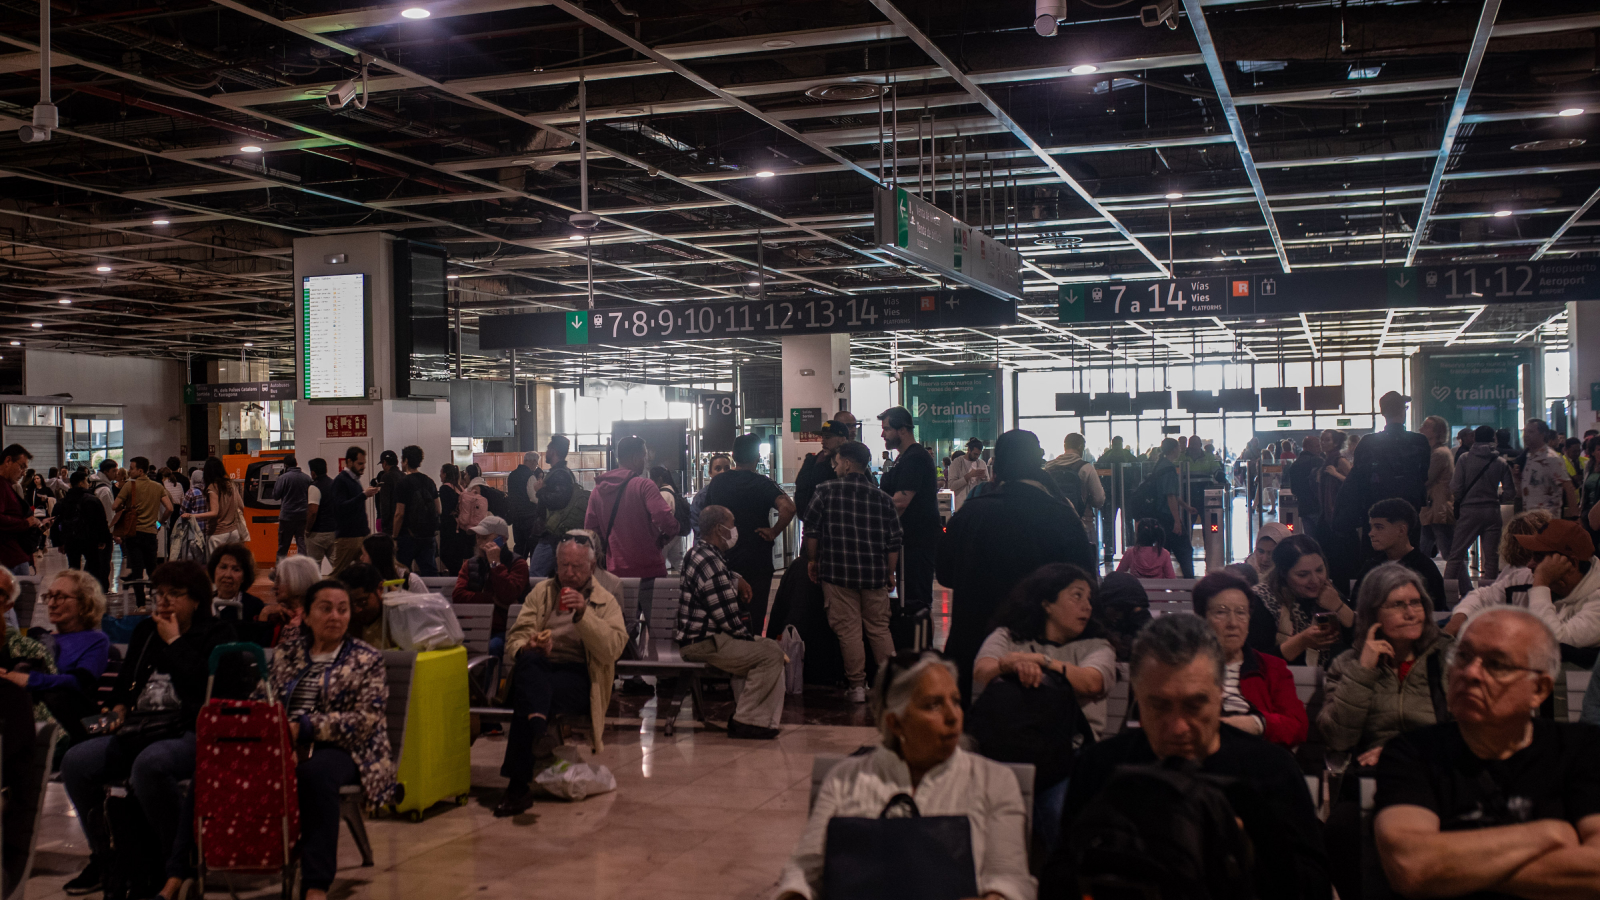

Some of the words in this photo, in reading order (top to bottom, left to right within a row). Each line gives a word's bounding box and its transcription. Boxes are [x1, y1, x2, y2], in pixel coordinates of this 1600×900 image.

[1539, 264, 1597, 274] Aeropuerto
[1539, 276, 1585, 287] Aeroport
[1191, 282, 1210, 291] Vías
[883, 297, 900, 306] Vías
[1109, 285, 1127, 314] 7
[1130, 300, 1141, 313] a
[1148, 283, 1188, 313] 14
[1191, 293, 1210, 302] Vies
[883, 308, 901, 316] Vies
[1191, 304, 1222, 312] PLATFORMS
[1454, 384, 1517, 400] trainlin
[930, 401, 991, 415] trainline
